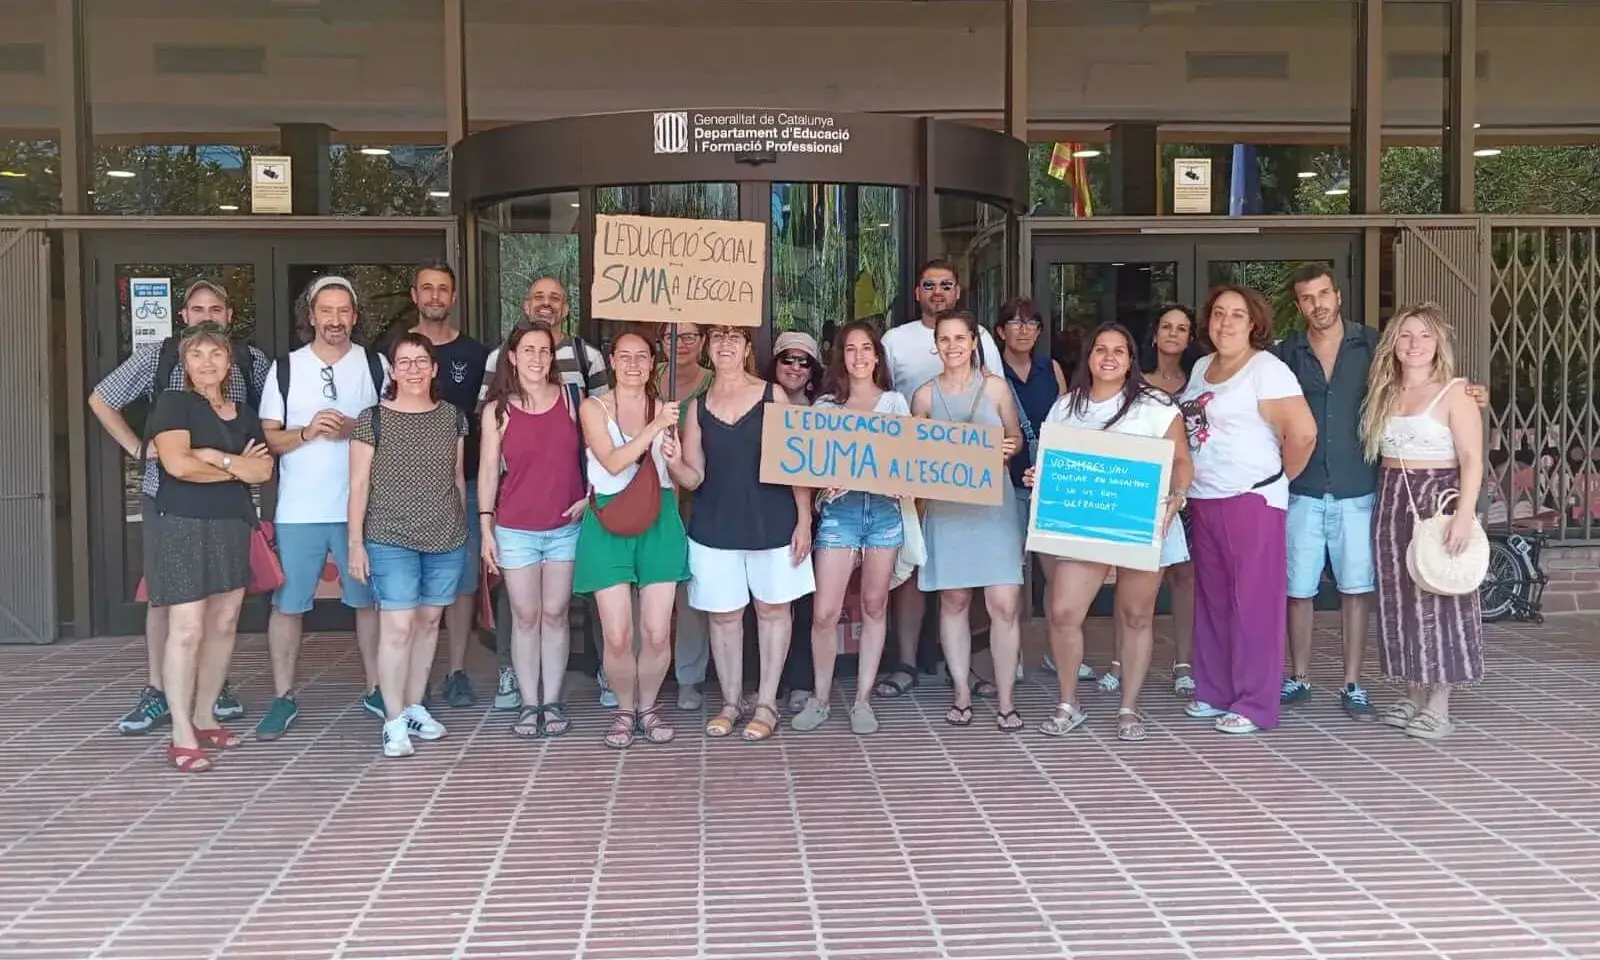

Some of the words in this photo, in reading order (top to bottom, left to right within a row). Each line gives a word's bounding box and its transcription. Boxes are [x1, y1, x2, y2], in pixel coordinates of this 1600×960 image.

[694, 113, 756, 125] Generalitat
[759, 113, 775, 125] de
[777, 113, 834, 128] Catalunya
[694, 128, 778, 140] Departament
[781, 128, 850, 140] d'Educació
[702, 141, 762, 152] Formació
[766, 141, 842, 153] Professional
[604, 220, 703, 258] L'EDUCACIÓ
[700, 231, 757, 264] SOCIAL
[598, 264, 671, 305] SUMA
[671, 274, 680, 296] A
[686, 275, 754, 303] L'ESCOLA
[780, 436, 878, 479] SUMA
[889, 459, 900, 478] A
[905, 459, 992, 489] L'ESCOLA
